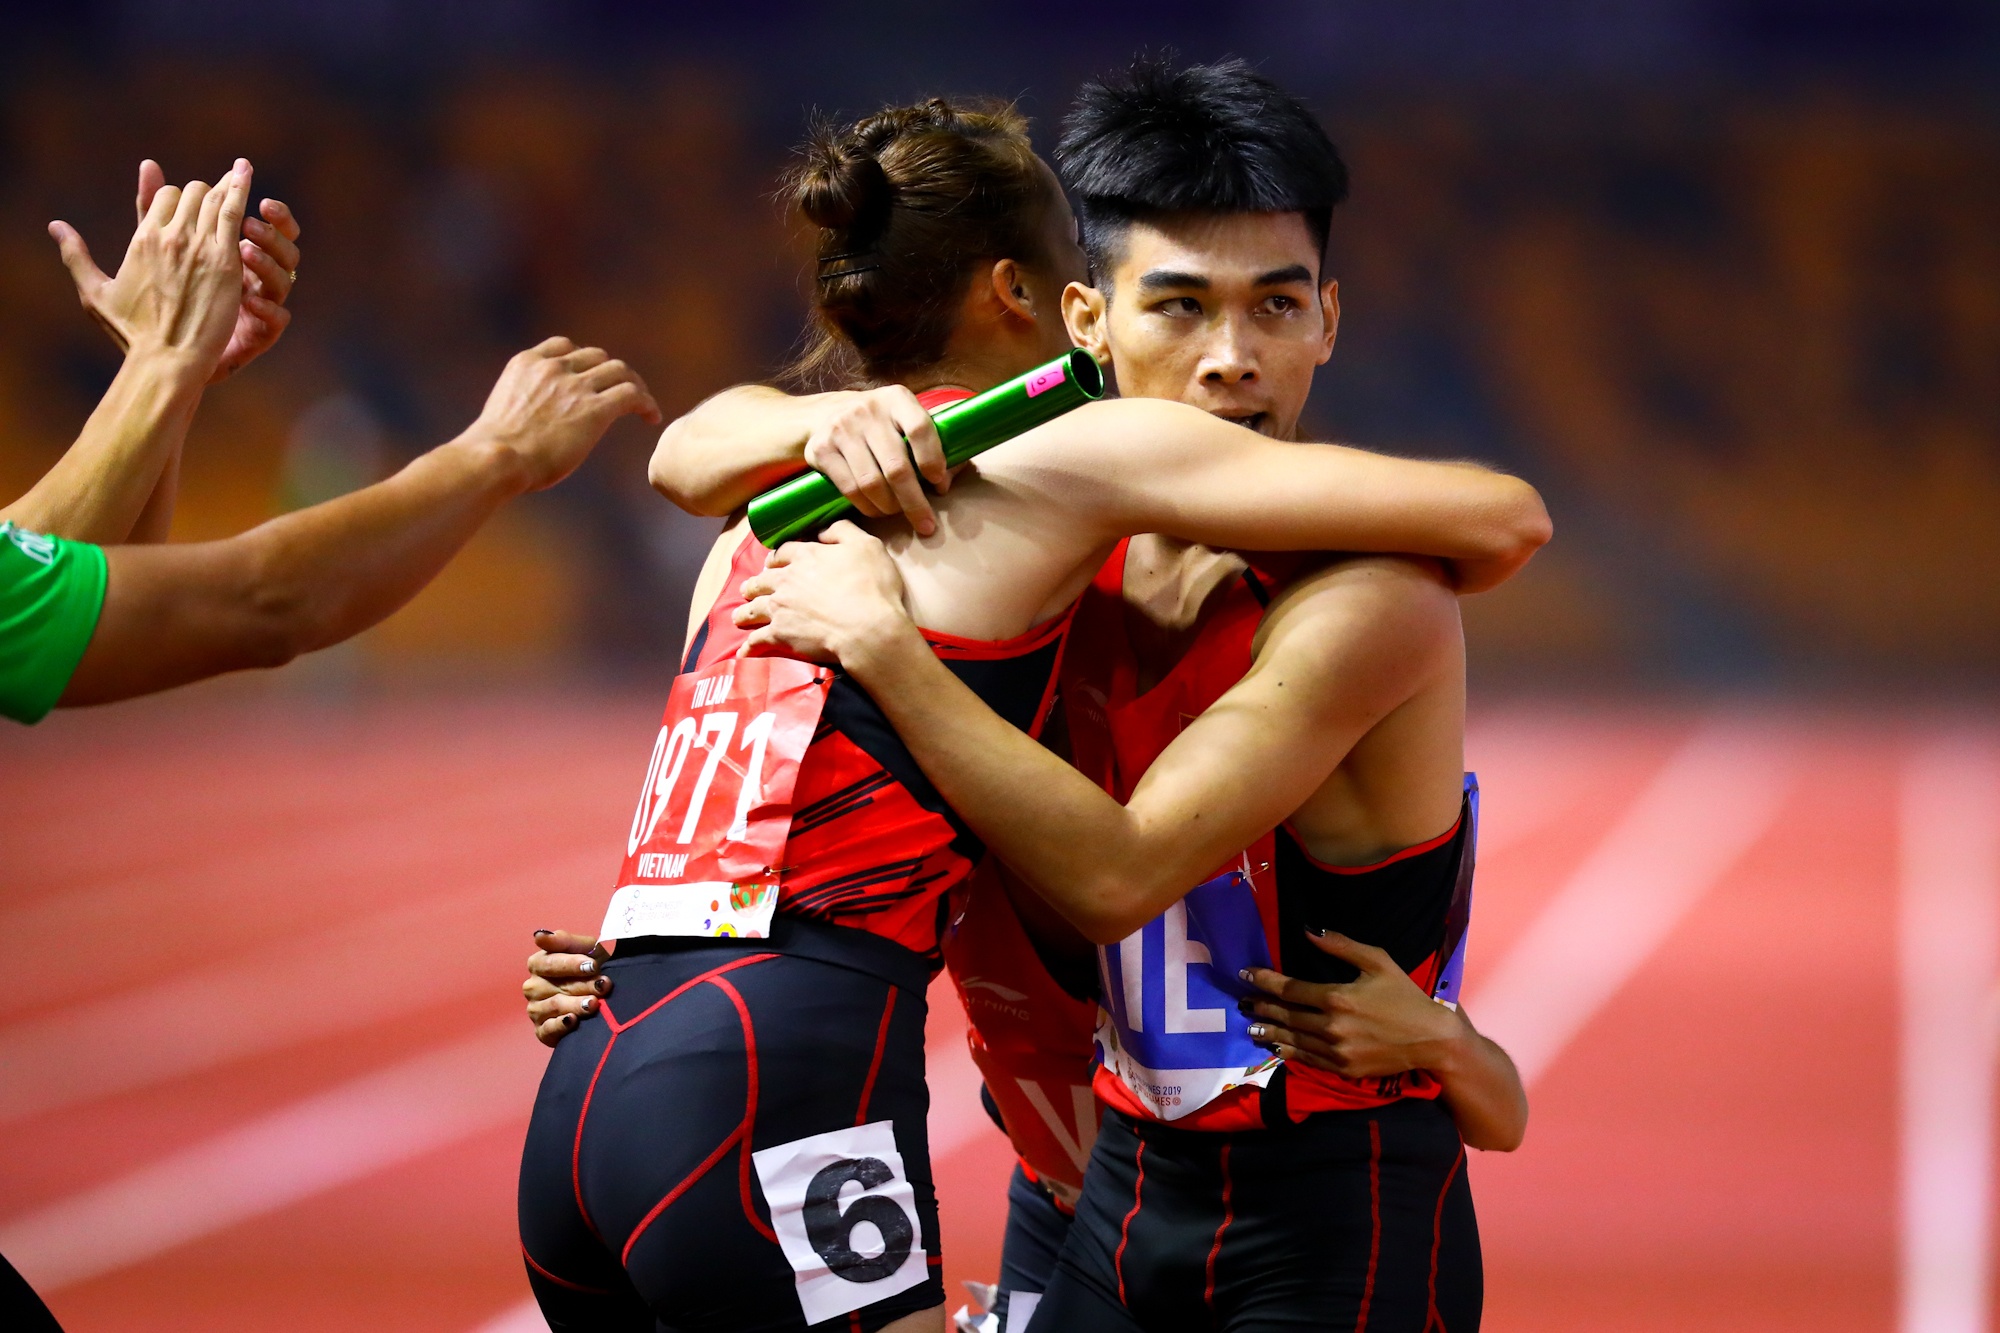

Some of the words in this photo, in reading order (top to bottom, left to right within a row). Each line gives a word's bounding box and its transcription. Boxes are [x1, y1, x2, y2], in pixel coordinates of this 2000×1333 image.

[691, 678, 711, 709] THI
[704, 675, 734, 706] LAN
[627, 712, 776, 858] 0971
[1163, 1086, 1181, 1095] 2019
[802, 1156, 914, 1284] 6
